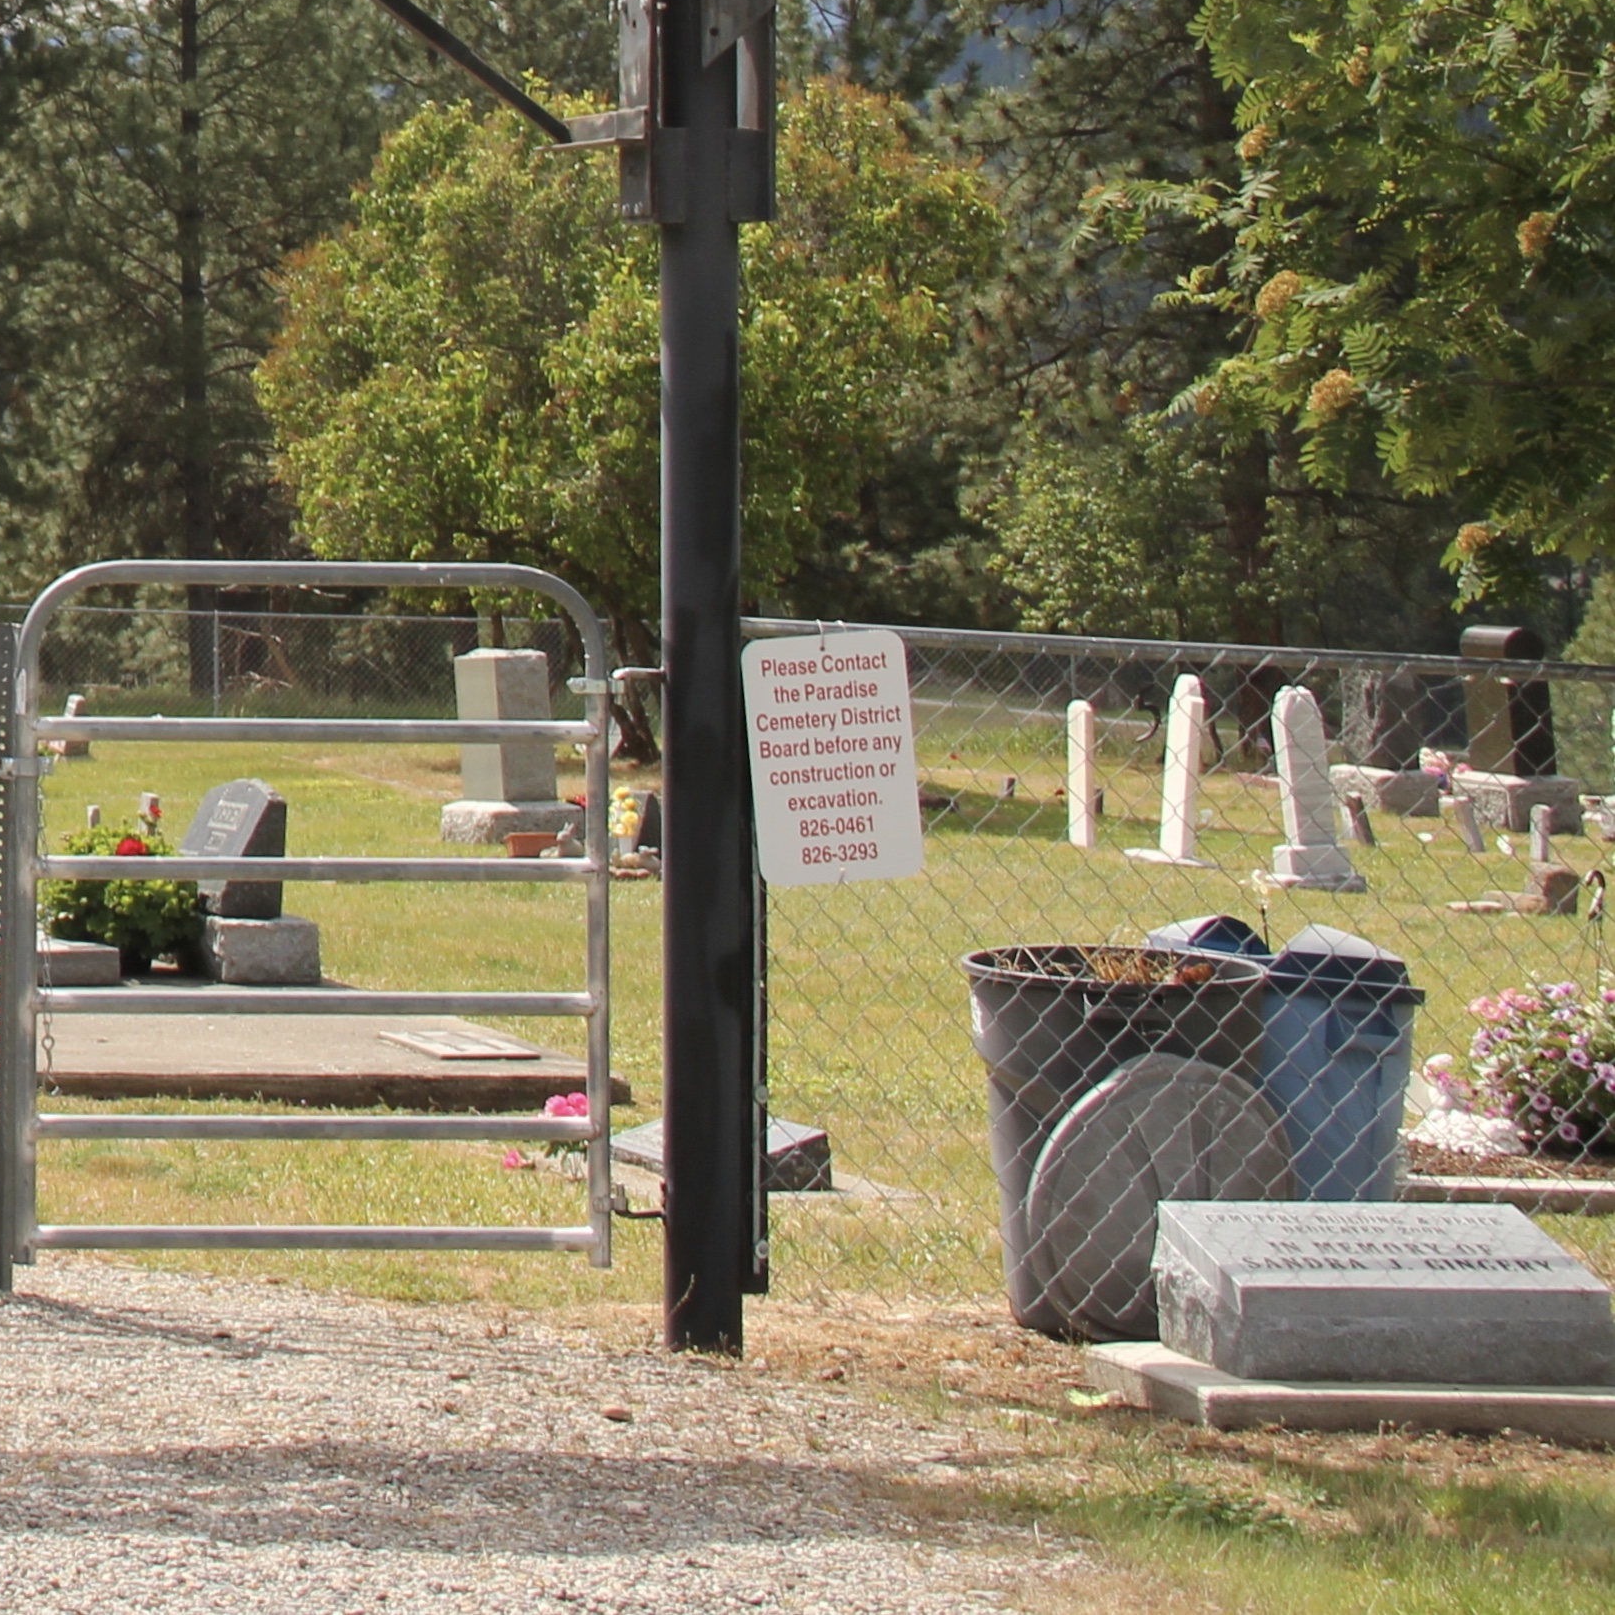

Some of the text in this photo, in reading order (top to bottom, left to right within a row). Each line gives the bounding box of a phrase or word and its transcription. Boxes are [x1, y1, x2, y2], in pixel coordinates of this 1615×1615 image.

[760, 652, 888, 678] Please Contact
[773, 680, 878, 704] the Paradise
[756, 705, 901, 733] Cemetery District
[759, 735, 902, 759] Board before any
[769, 761, 897, 786] construction or
[787, 789, 883, 812] excavation.
[799, 816, 875, 838] 826-0461
[801, 842, 879, 865] 826-3293
[1269, 1241, 1492, 1256] IN MEMORY OF
[1242, 1257, 1554, 1272] SANDRA J. GINGERY
